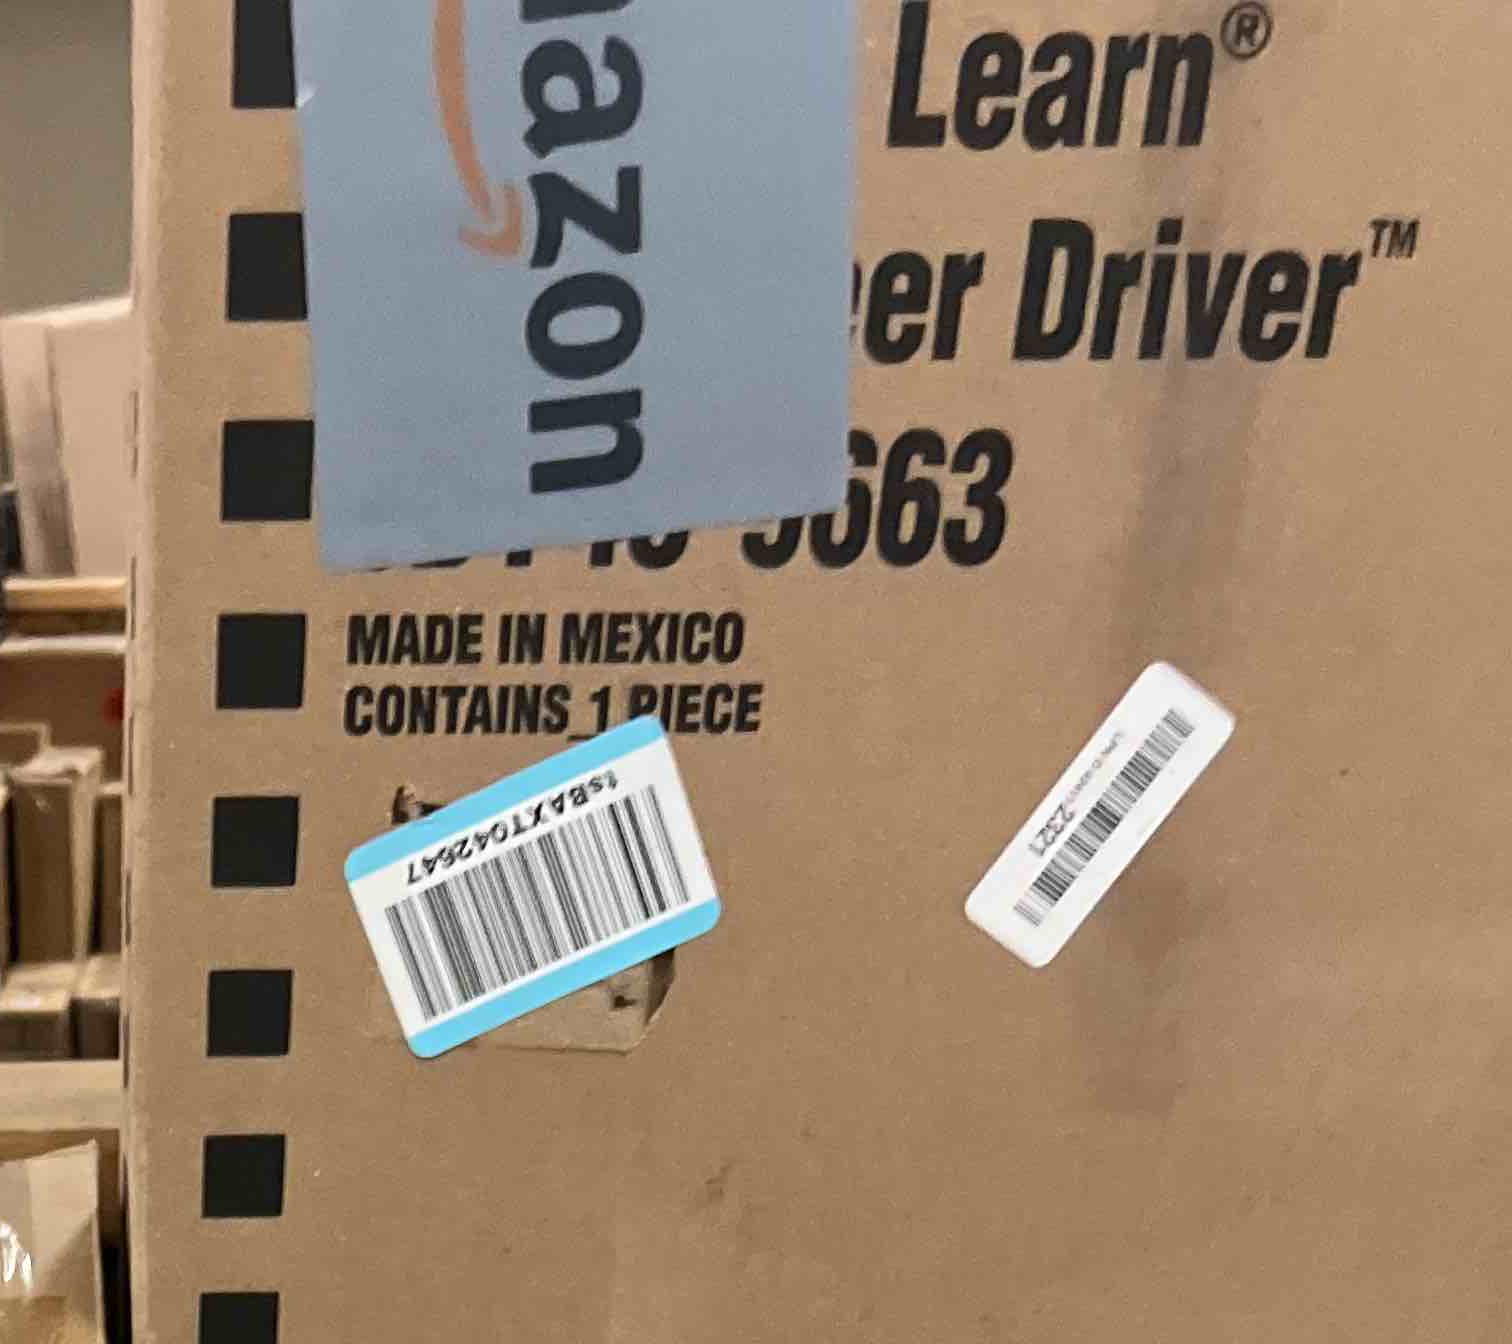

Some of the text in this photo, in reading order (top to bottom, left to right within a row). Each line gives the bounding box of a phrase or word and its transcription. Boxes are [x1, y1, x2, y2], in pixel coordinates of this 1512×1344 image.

[850, 246, 985, 363] er
[347, 612, 744, 665] MADE IN MEXICO
[344, 684, 569, 736] CONTAINS
[626, 683, 763, 734] PIECE
